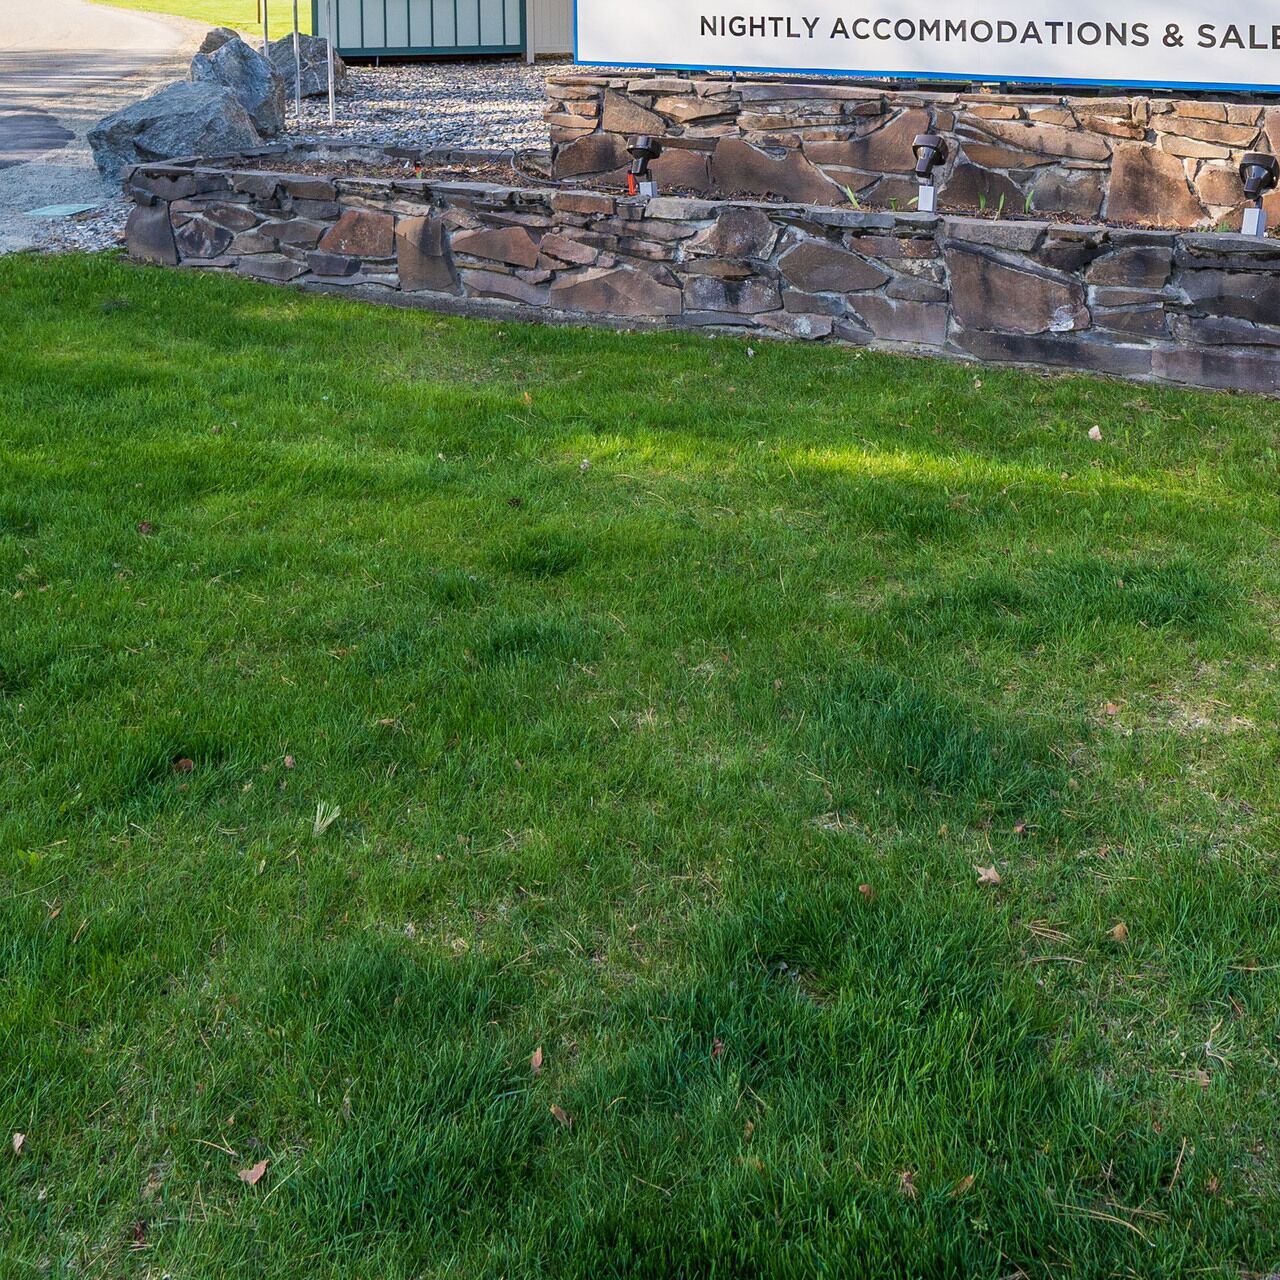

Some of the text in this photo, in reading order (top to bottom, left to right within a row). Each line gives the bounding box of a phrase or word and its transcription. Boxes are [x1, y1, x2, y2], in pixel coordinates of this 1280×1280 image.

[700, 15, 820, 39] NIGHTLY
[829, 17, 1150, 47] ACCOMMODATIONS
[1162, 23, 1184, 48] &
